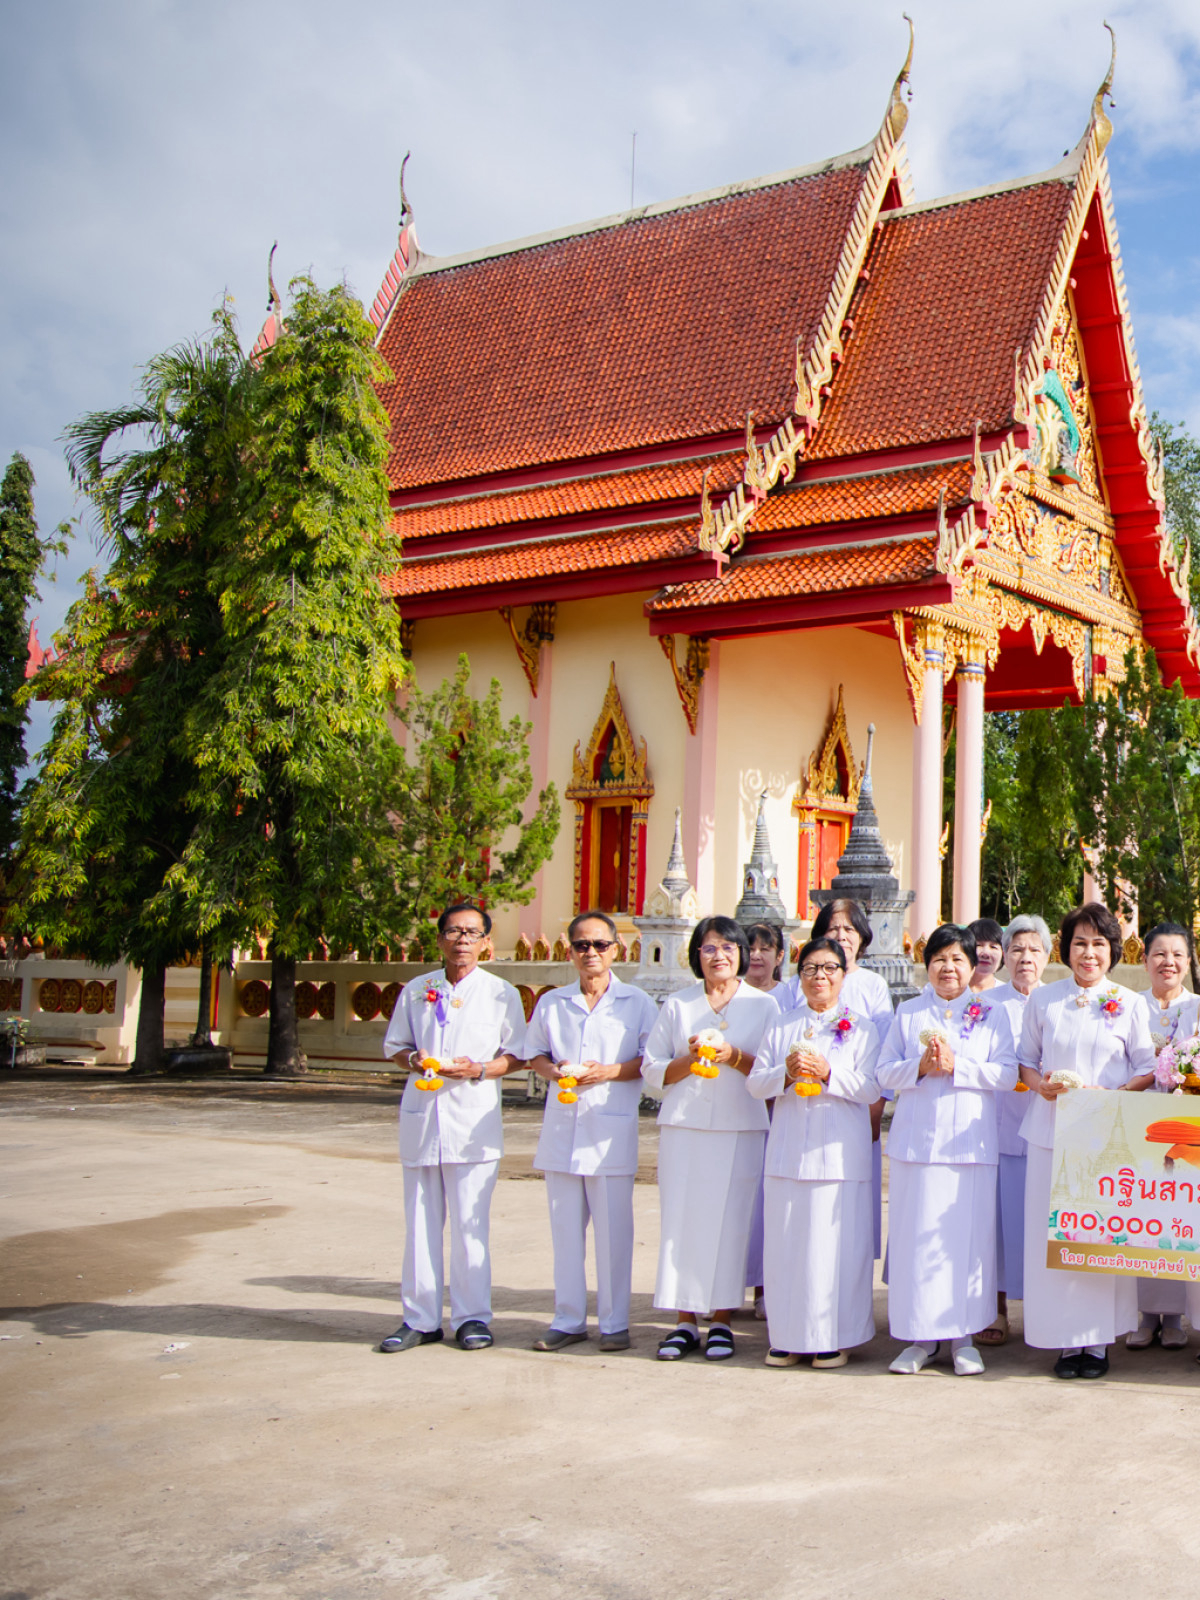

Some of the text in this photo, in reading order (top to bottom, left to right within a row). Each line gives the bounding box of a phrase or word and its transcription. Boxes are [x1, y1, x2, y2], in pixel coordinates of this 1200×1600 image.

[1060, 1211, 1163, 1236] ๓๐,๐๐๐
[1171, 1217, 1193, 1239] วัด
[1061, 1249, 1084, 1265] โดย
[1088, 1254, 1184, 1275] คณะศิษยานุศิษย์
